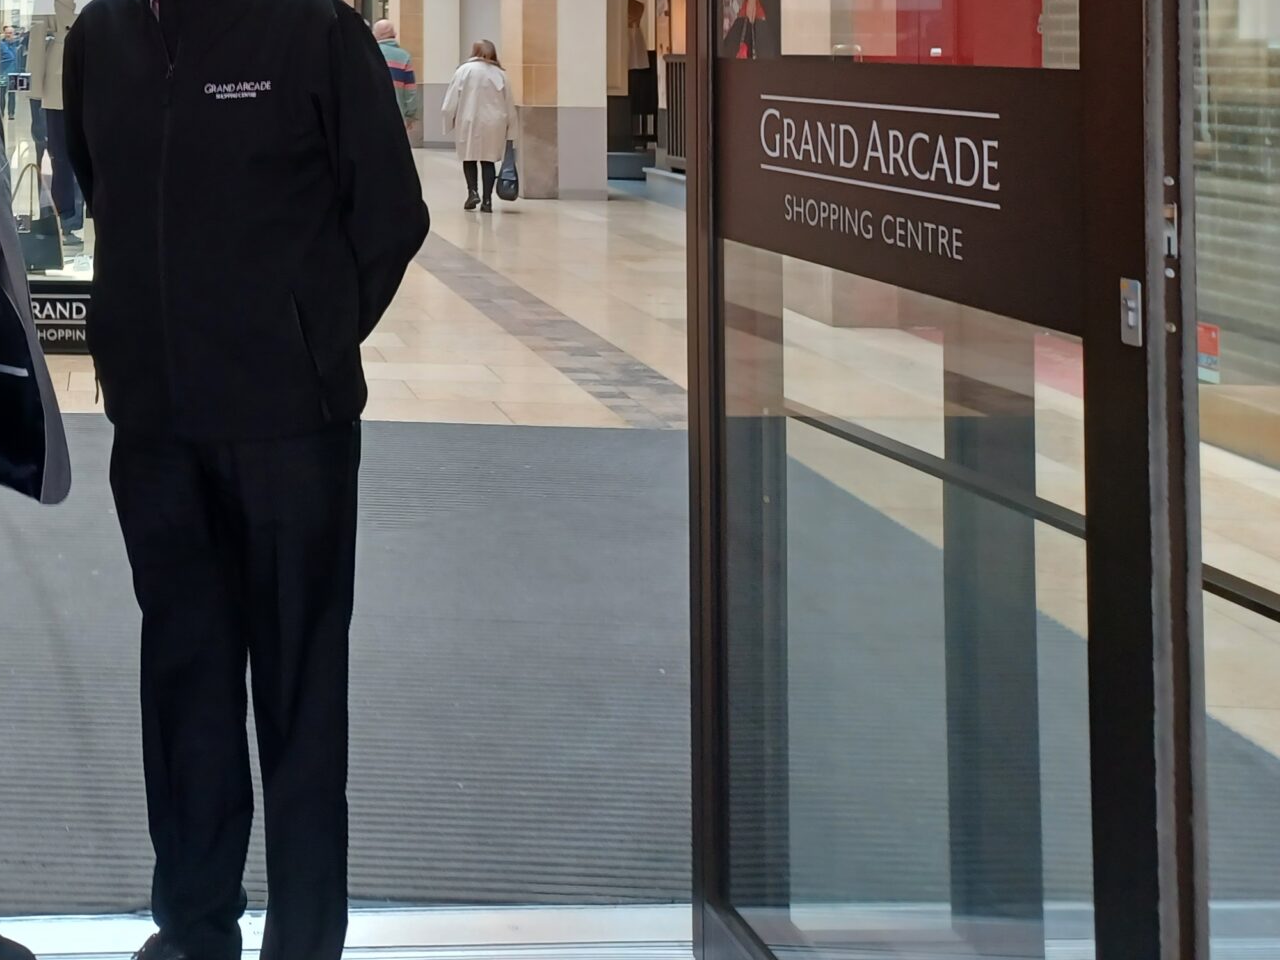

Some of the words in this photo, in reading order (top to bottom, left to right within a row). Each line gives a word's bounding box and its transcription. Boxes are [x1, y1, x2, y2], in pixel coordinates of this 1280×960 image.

[204, 83, 235, 94] GRAND
[236, 80, 272, 92] ARCADE
[760, 107, 859, 170] GRAND
[863, 119, 1001, 191] ARCADE
[784, 193, 873, 240] SHOPPING
[881, 214, 963, 261] CENTRE
